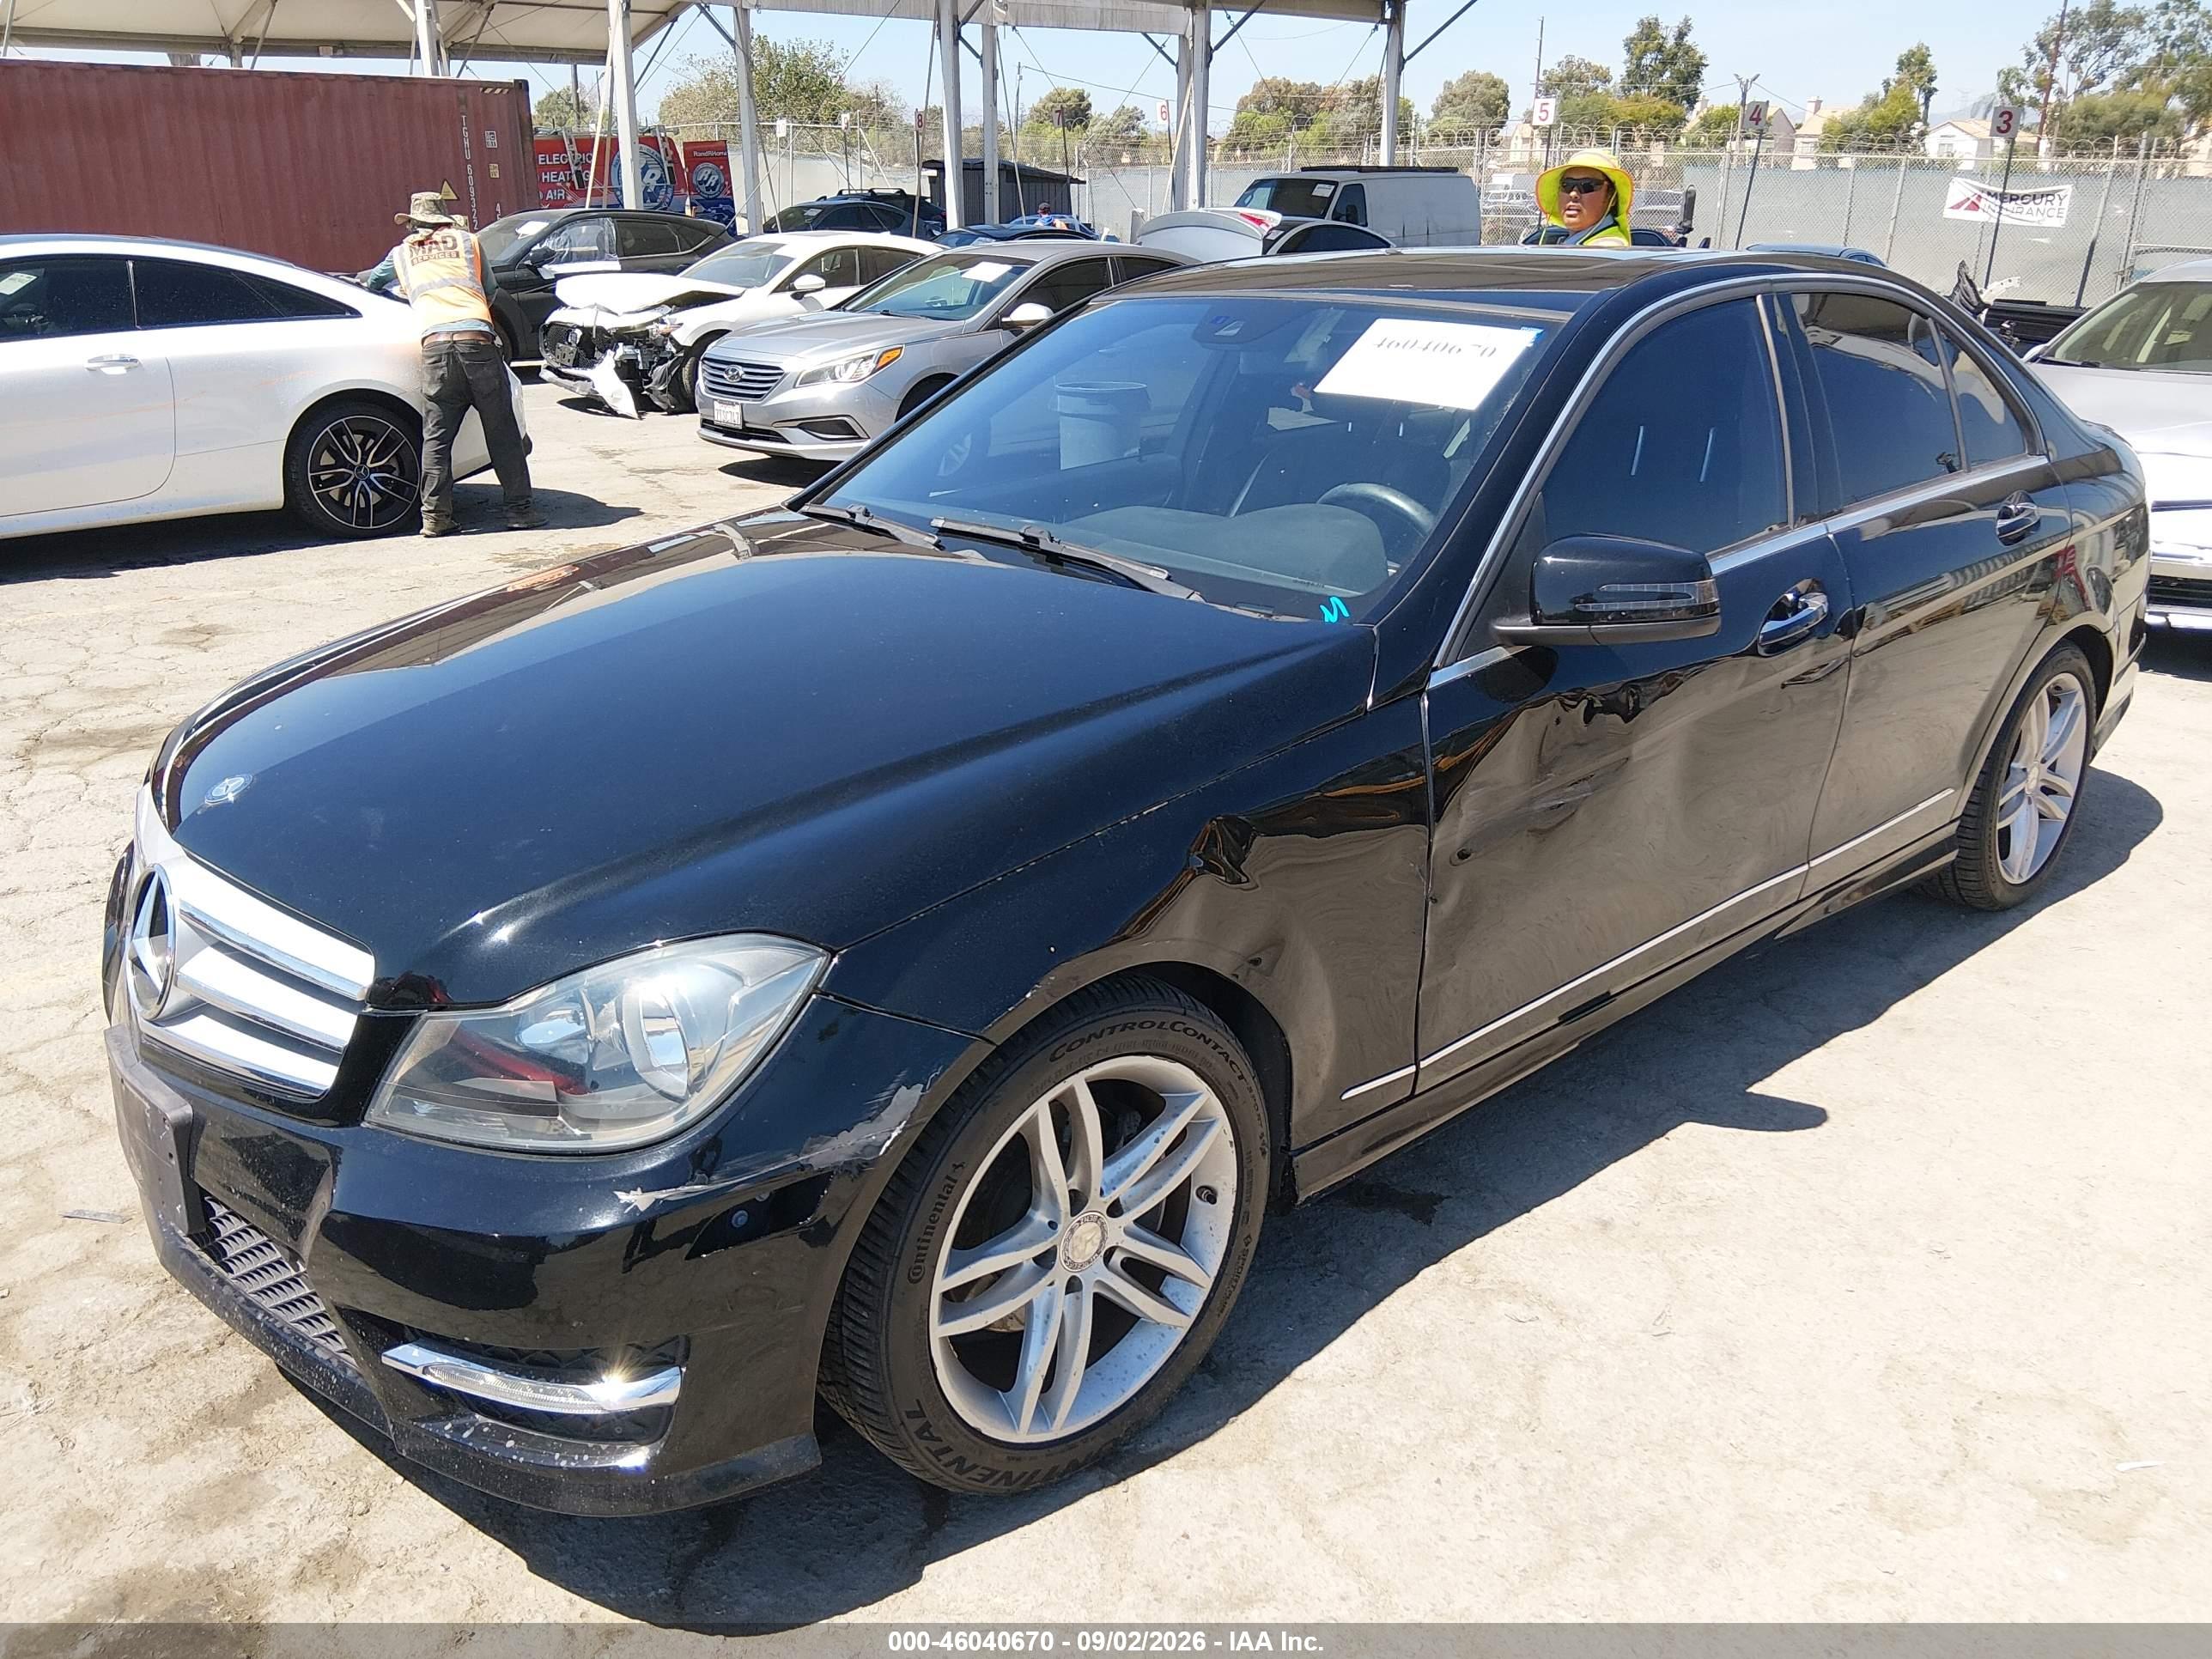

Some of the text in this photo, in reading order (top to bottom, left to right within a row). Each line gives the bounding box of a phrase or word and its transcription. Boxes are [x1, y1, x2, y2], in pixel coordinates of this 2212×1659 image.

[917, 113, 923, 128] 8
[1054, 109, 1063, 126] 7
[1160, 104, 1169, 121] 6
[1538, 102, 1550, 122] 5
[1748, 104, 1763, 125] 4
[1996, 110, 2014, 134] 3
[538, 153, 593, 165] ELECRIC
[462, 115, 479, 230] TGHU 609322
[542, 170, 591, 183] HEATG
[546, 190, 566, 201] AIR
[1986, 191, 2068, 206] MERCURY
[1983, 203, 2067, 219] INURANCE
[409, 234, 459, 256] MAD
[412, 251, 459, 265] SERVICES
[907, 1174, 959, 1285] Continental
